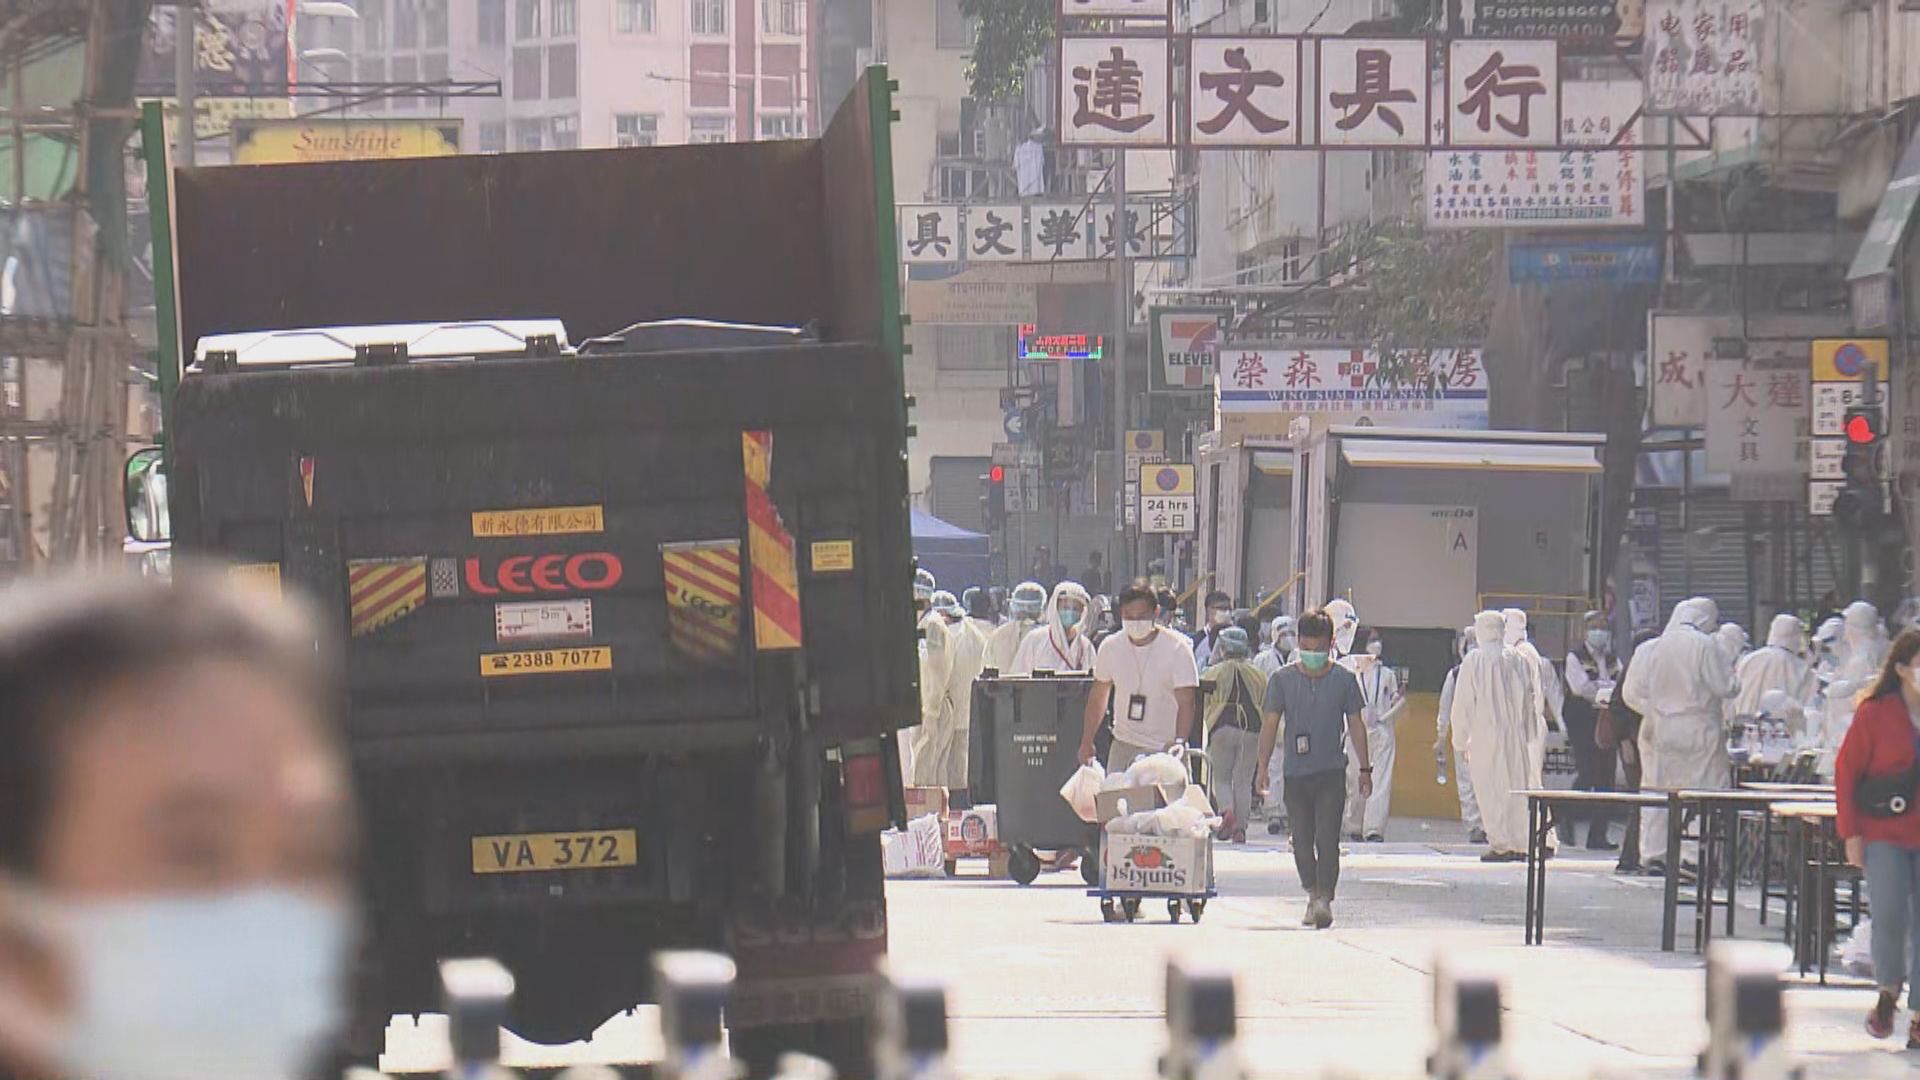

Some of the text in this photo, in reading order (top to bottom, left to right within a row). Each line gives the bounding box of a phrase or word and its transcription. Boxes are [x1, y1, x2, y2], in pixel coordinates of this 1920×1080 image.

[293, 127, 401, 151] Sunshine
[1316, 390, 1347, 401] SUM
[1147, 500, 1188, 511] 24 hrs
[1153, 513, 1185, 529] 全日
[1453, 532, 1468, 550] A
[464, 551, 623, 595] LEEO
[512, 650, 601, 668] 2388 7077
[492, 836, 619, 867] VA 372
[1112, 865, 1187, 888] Sunkist
